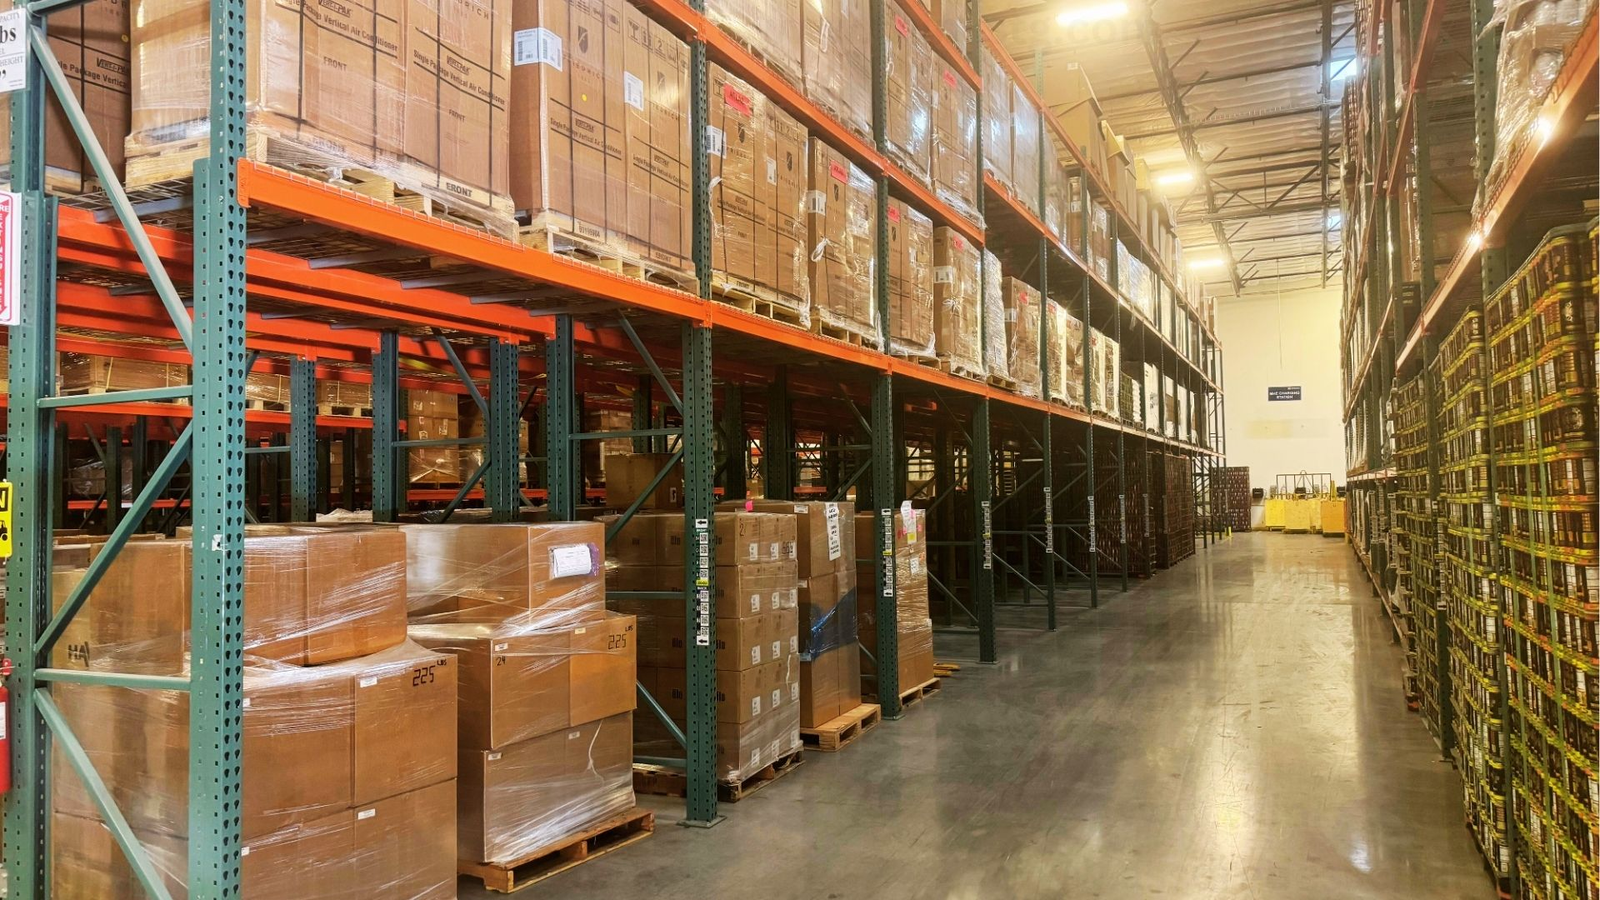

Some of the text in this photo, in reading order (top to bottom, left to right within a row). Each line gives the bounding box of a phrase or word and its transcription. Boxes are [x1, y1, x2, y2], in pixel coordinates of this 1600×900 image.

[323, 56, 347, 71] FRONT
[608, 634, 627, 650] 225
[413, 665, 436, 686] 225
